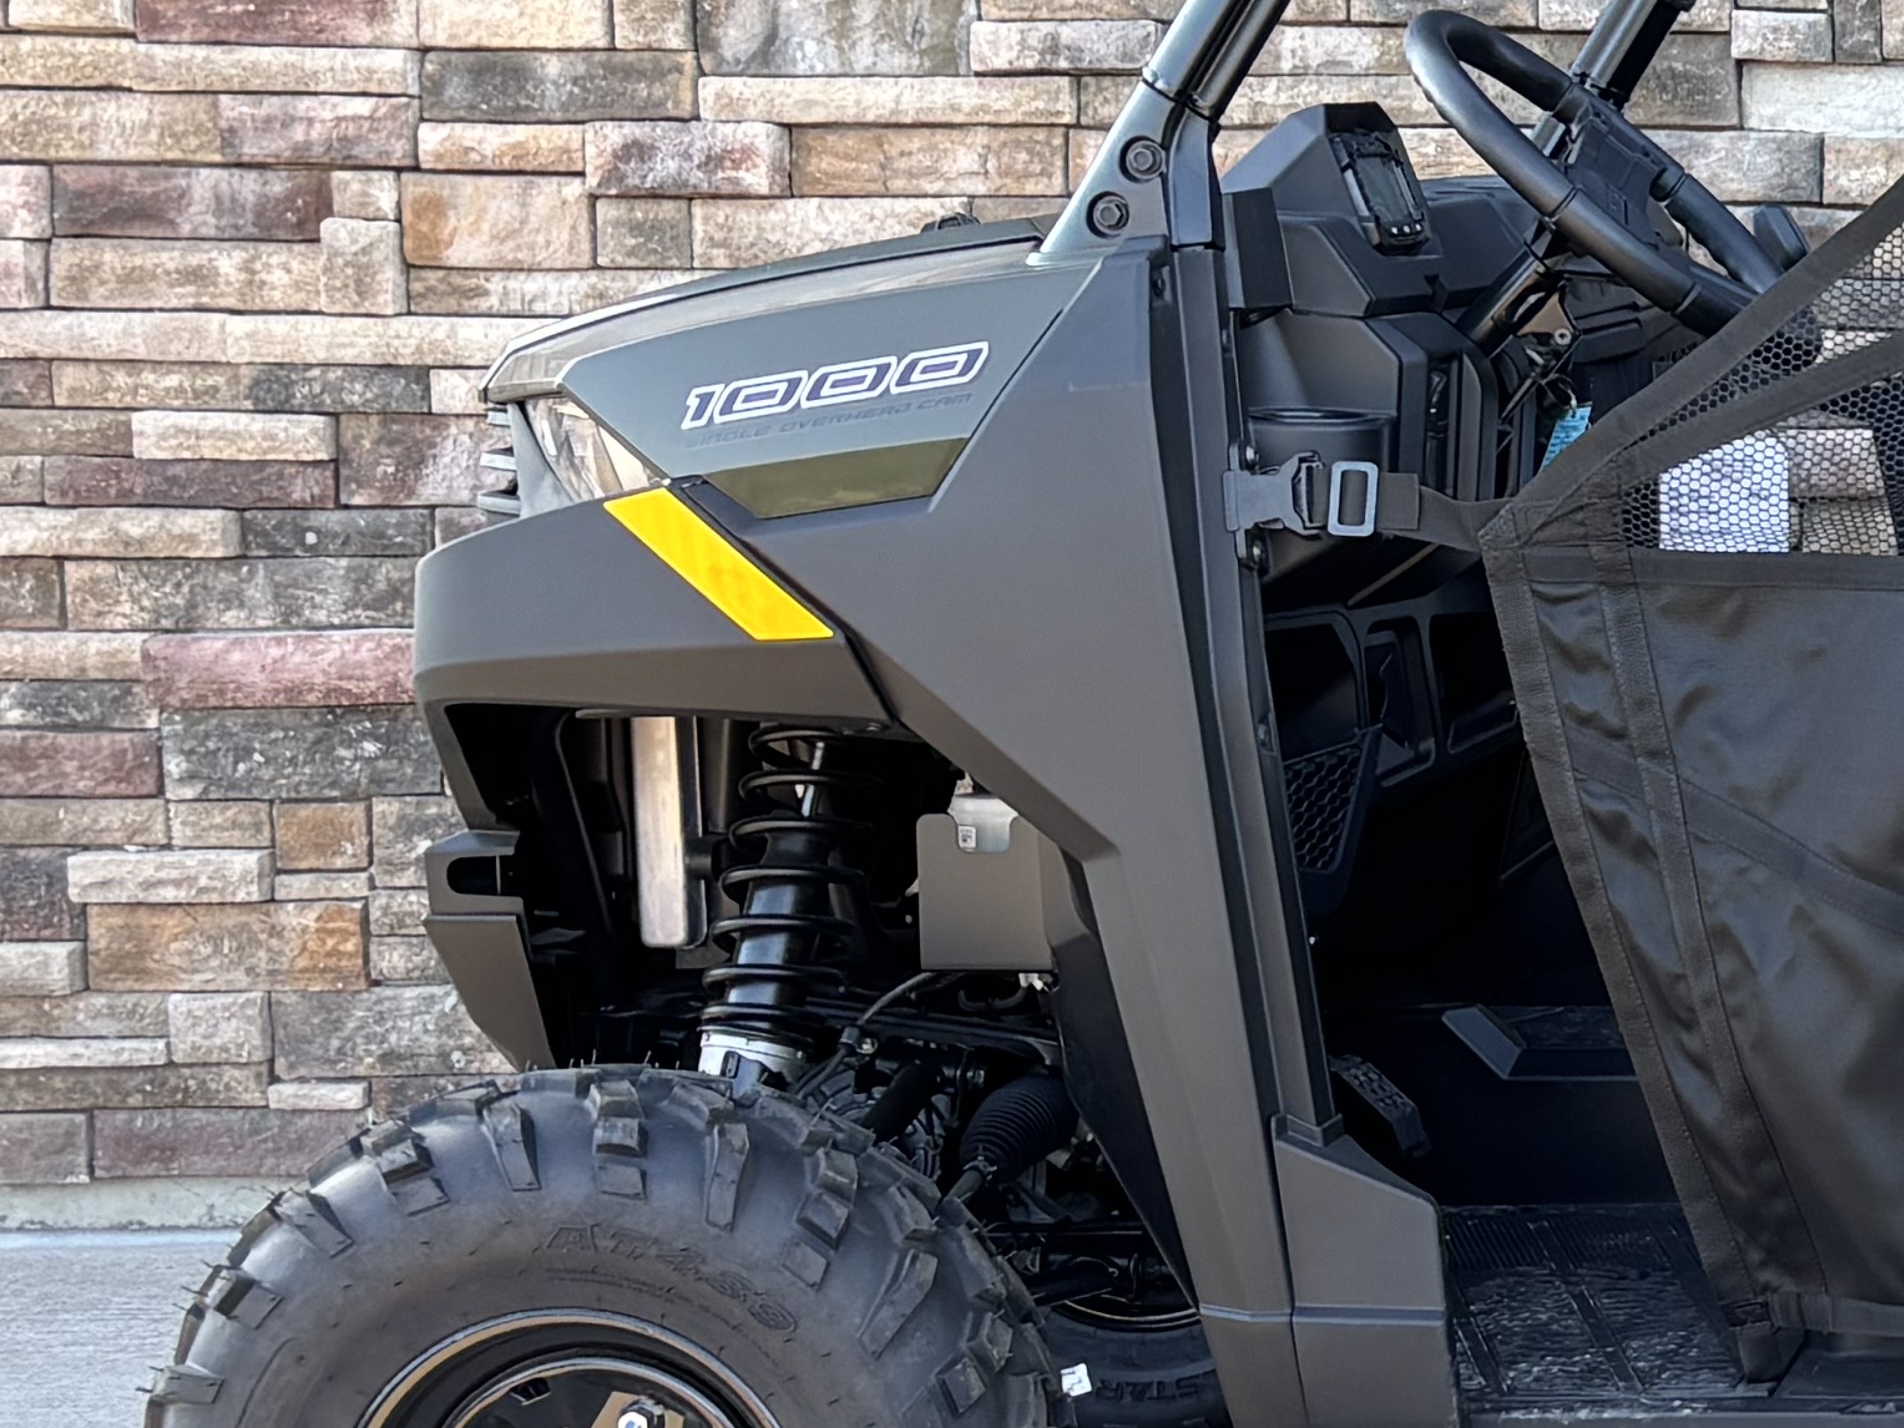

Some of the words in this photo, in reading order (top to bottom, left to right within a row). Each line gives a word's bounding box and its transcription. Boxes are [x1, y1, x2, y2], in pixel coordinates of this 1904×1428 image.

[681, 340, 989, 430] 1000
[685, 421, 771, 450] SINGLE
[778, 402, 913, 433] OVERHEAD
[917, 391, 973, 412] CAM
